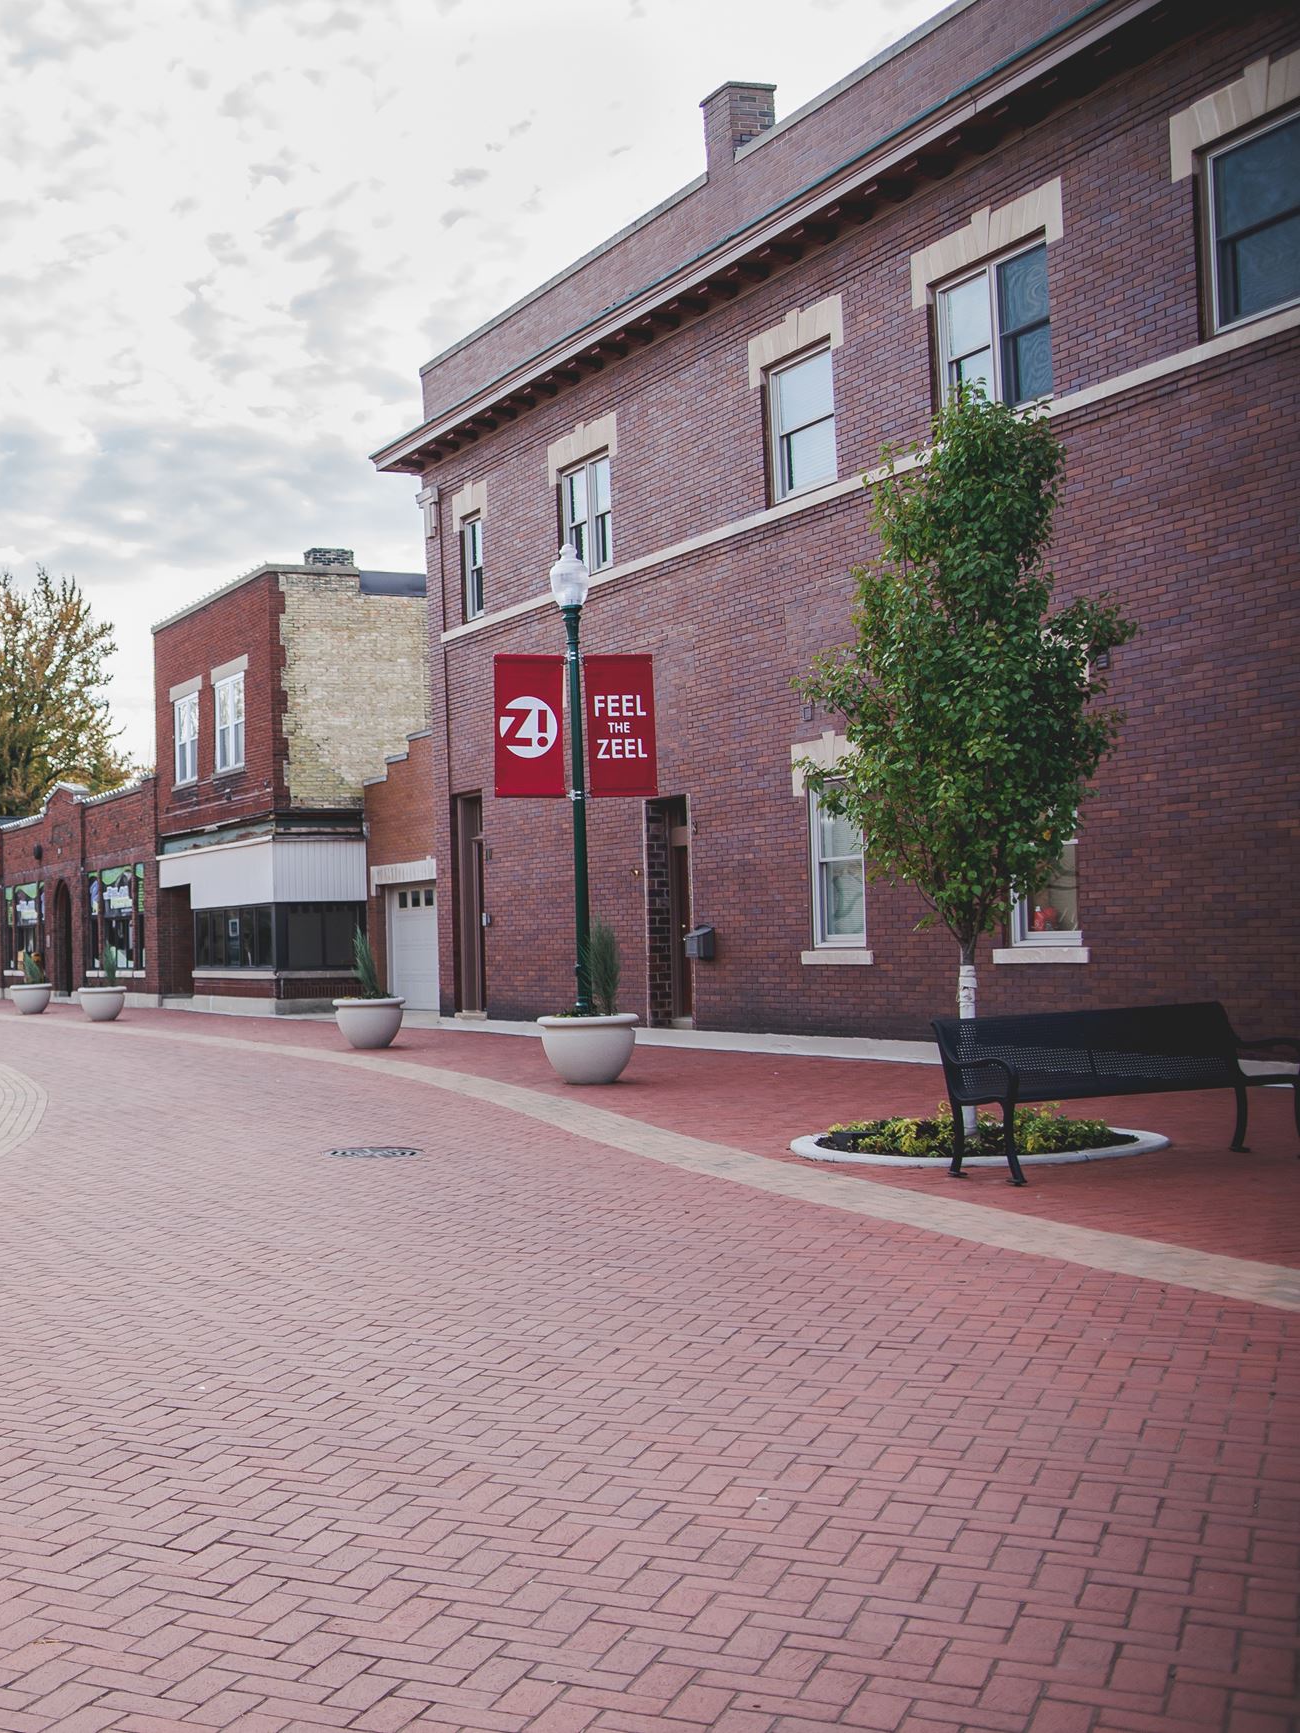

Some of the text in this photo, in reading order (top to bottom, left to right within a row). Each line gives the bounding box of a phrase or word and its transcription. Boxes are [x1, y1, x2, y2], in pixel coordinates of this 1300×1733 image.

[593, 694, 647, 717] FEEL
[607, 722, 631, 734] THE
[596, 738, 648, 759] ZEEL
